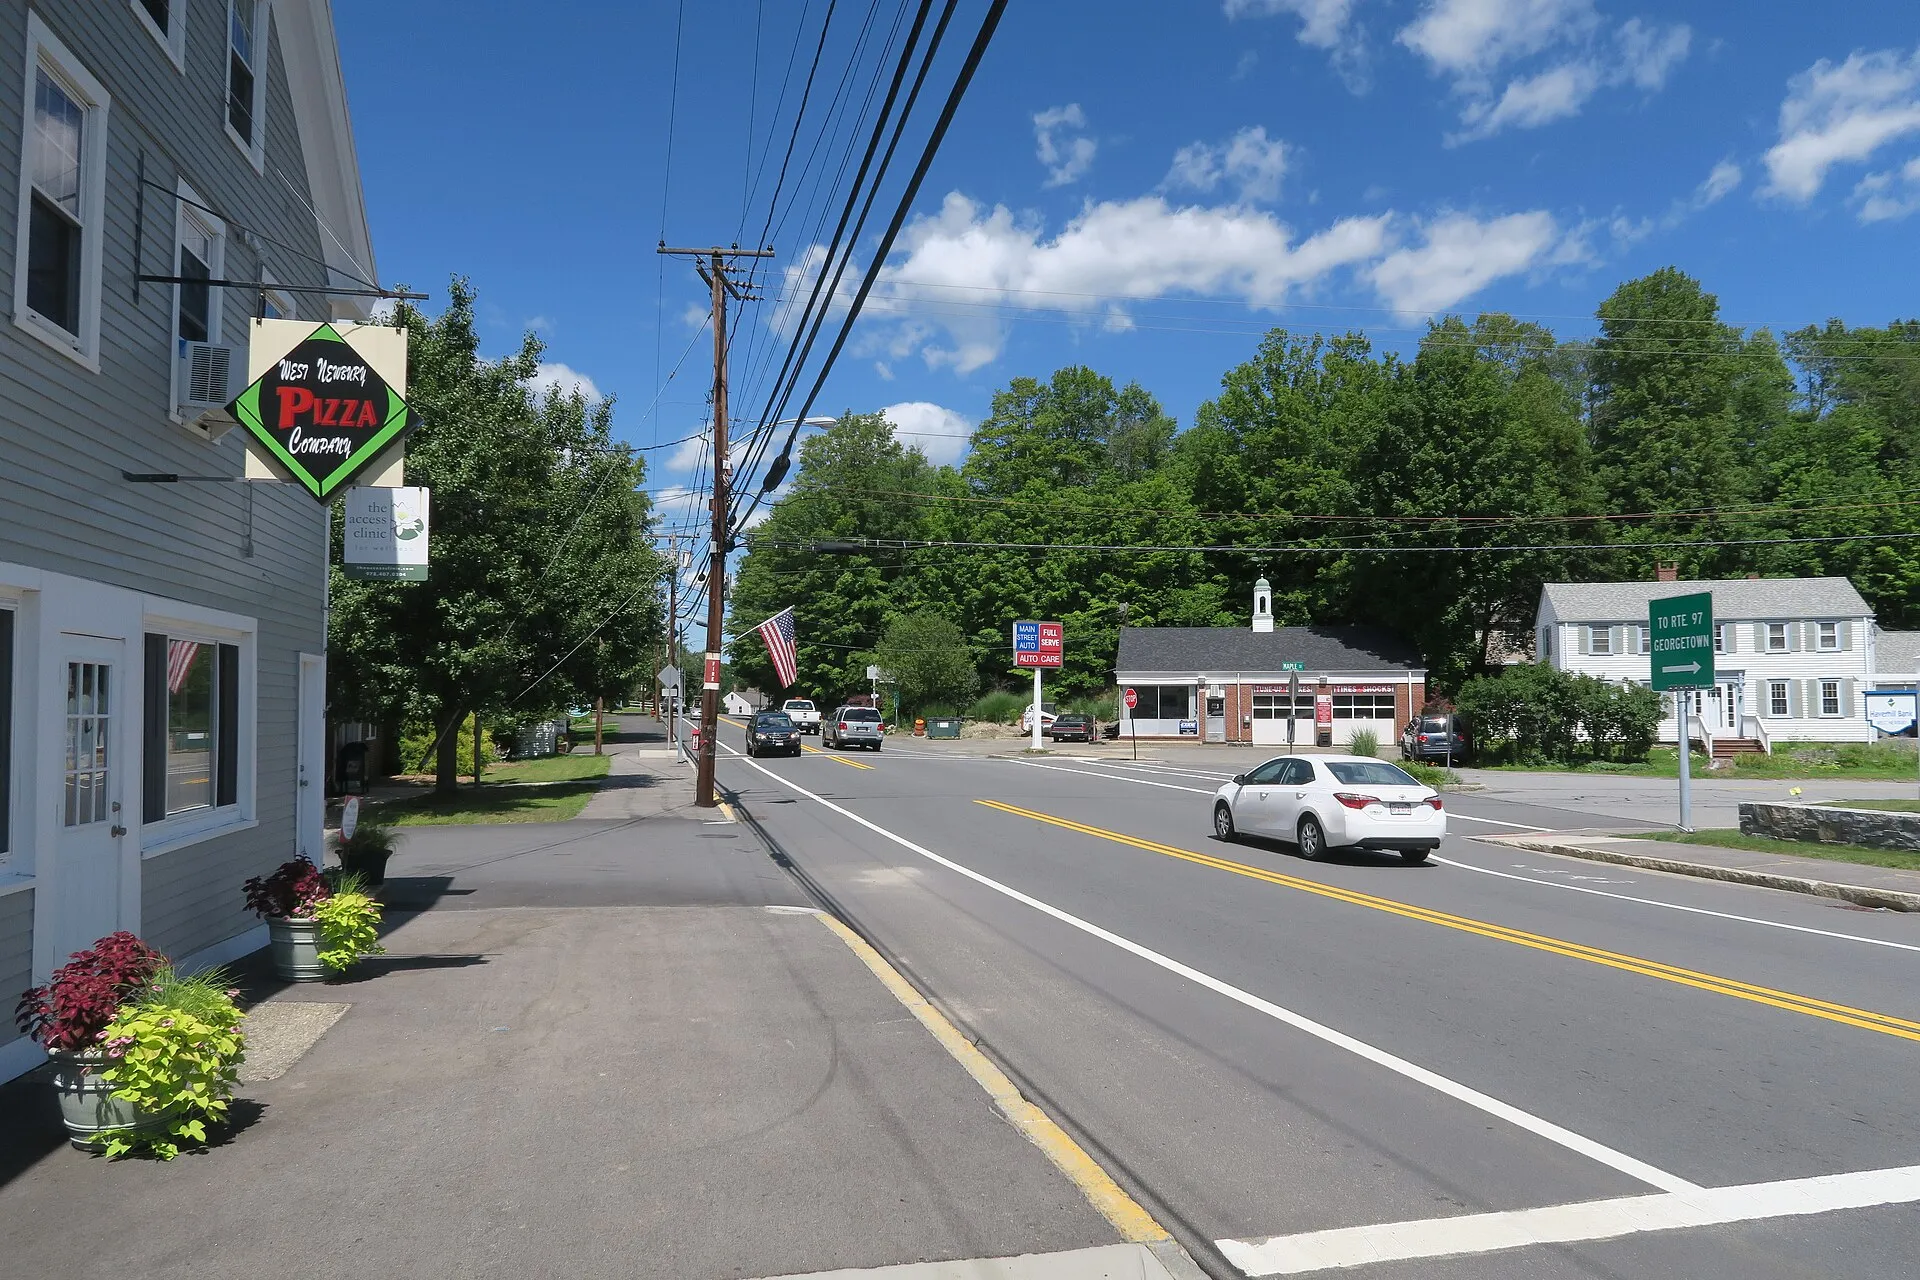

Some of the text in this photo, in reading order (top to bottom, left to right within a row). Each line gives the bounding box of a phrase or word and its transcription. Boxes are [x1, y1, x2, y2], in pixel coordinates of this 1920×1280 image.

[368, 502, 387, 513] the
[349, 516, 387, 524] access
[353, 528, 387, 538] clinic
[1658, 612, 1703, 629] TO RTE 97
[1654, 634, 1709, 651] GEORGETOWN
